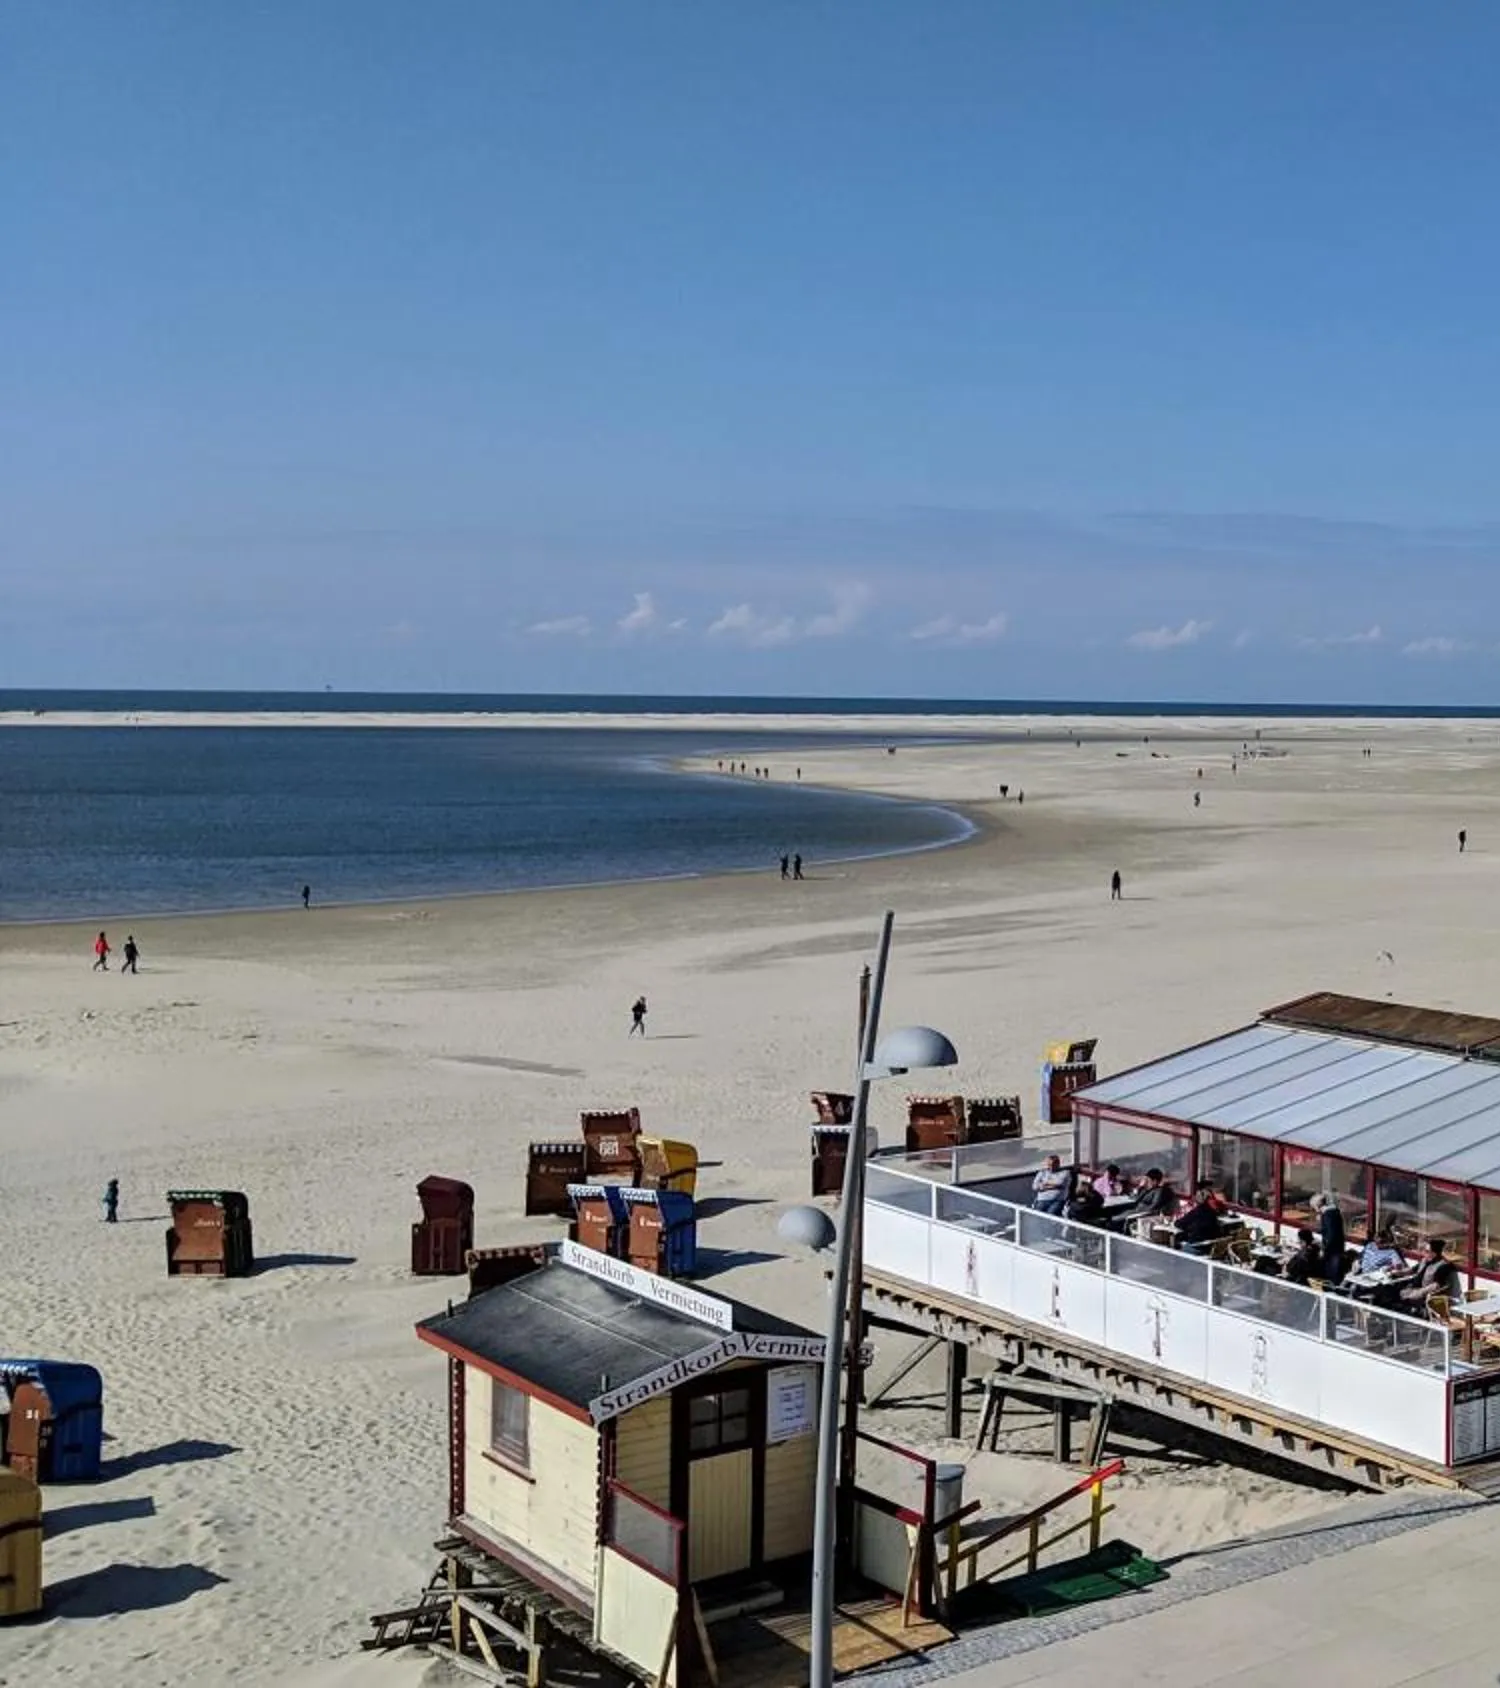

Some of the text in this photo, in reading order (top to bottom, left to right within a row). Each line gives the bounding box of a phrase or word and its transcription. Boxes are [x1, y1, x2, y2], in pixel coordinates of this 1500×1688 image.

[571, 1246, 724, 1323] Strandkorb Vermietung
[600, 1339, 737, 1414] Strandkorb
